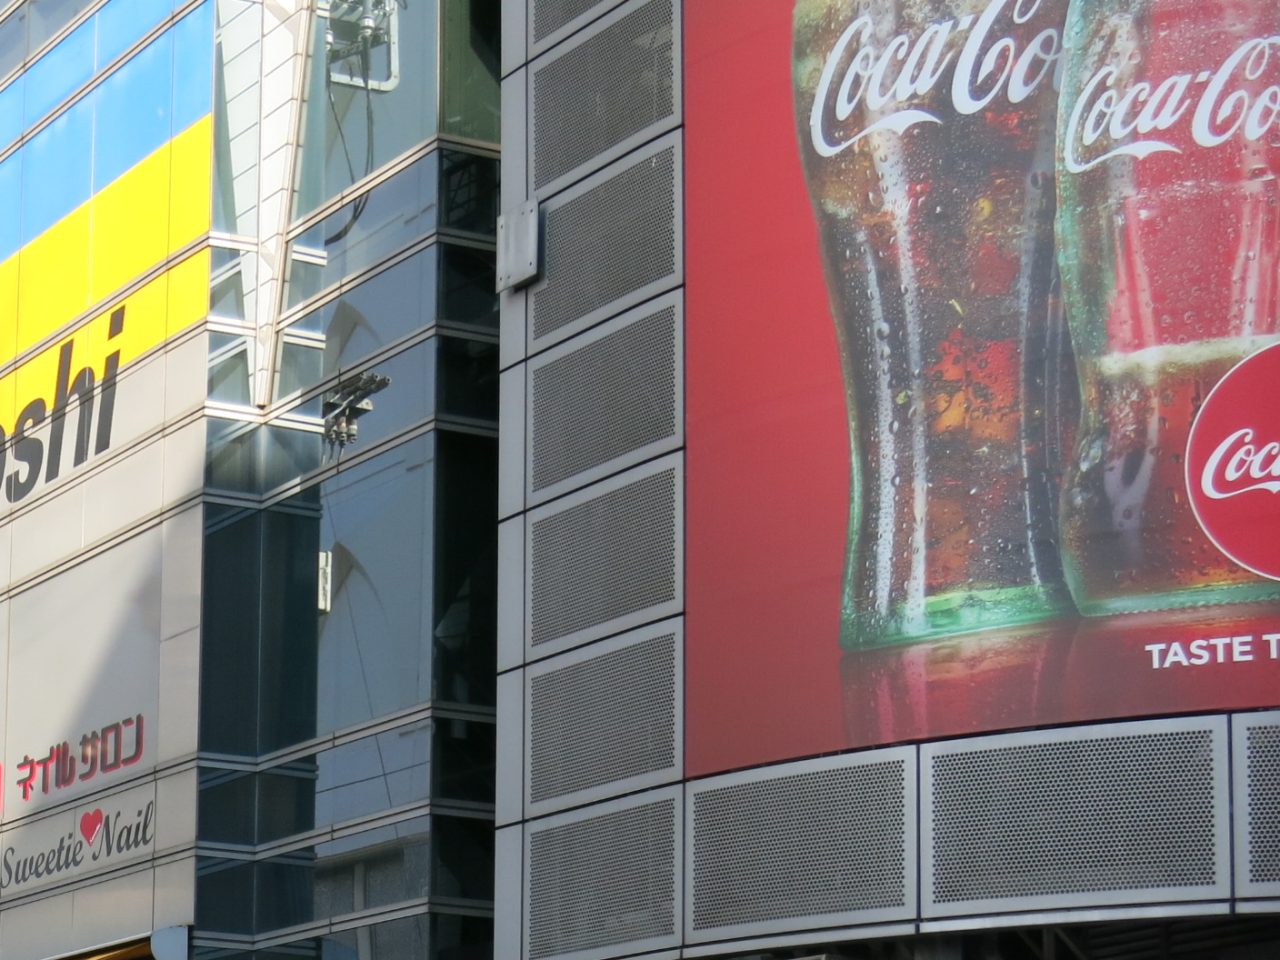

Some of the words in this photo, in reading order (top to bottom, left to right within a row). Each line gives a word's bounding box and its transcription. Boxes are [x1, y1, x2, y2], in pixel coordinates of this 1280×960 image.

[1145, 635, 1253, 669] TASTE
[16, 713, 145, 801] ネイルサロン
[0, 831, 84, 889] Sweetie
[91, 799, 154, 862] Nail
